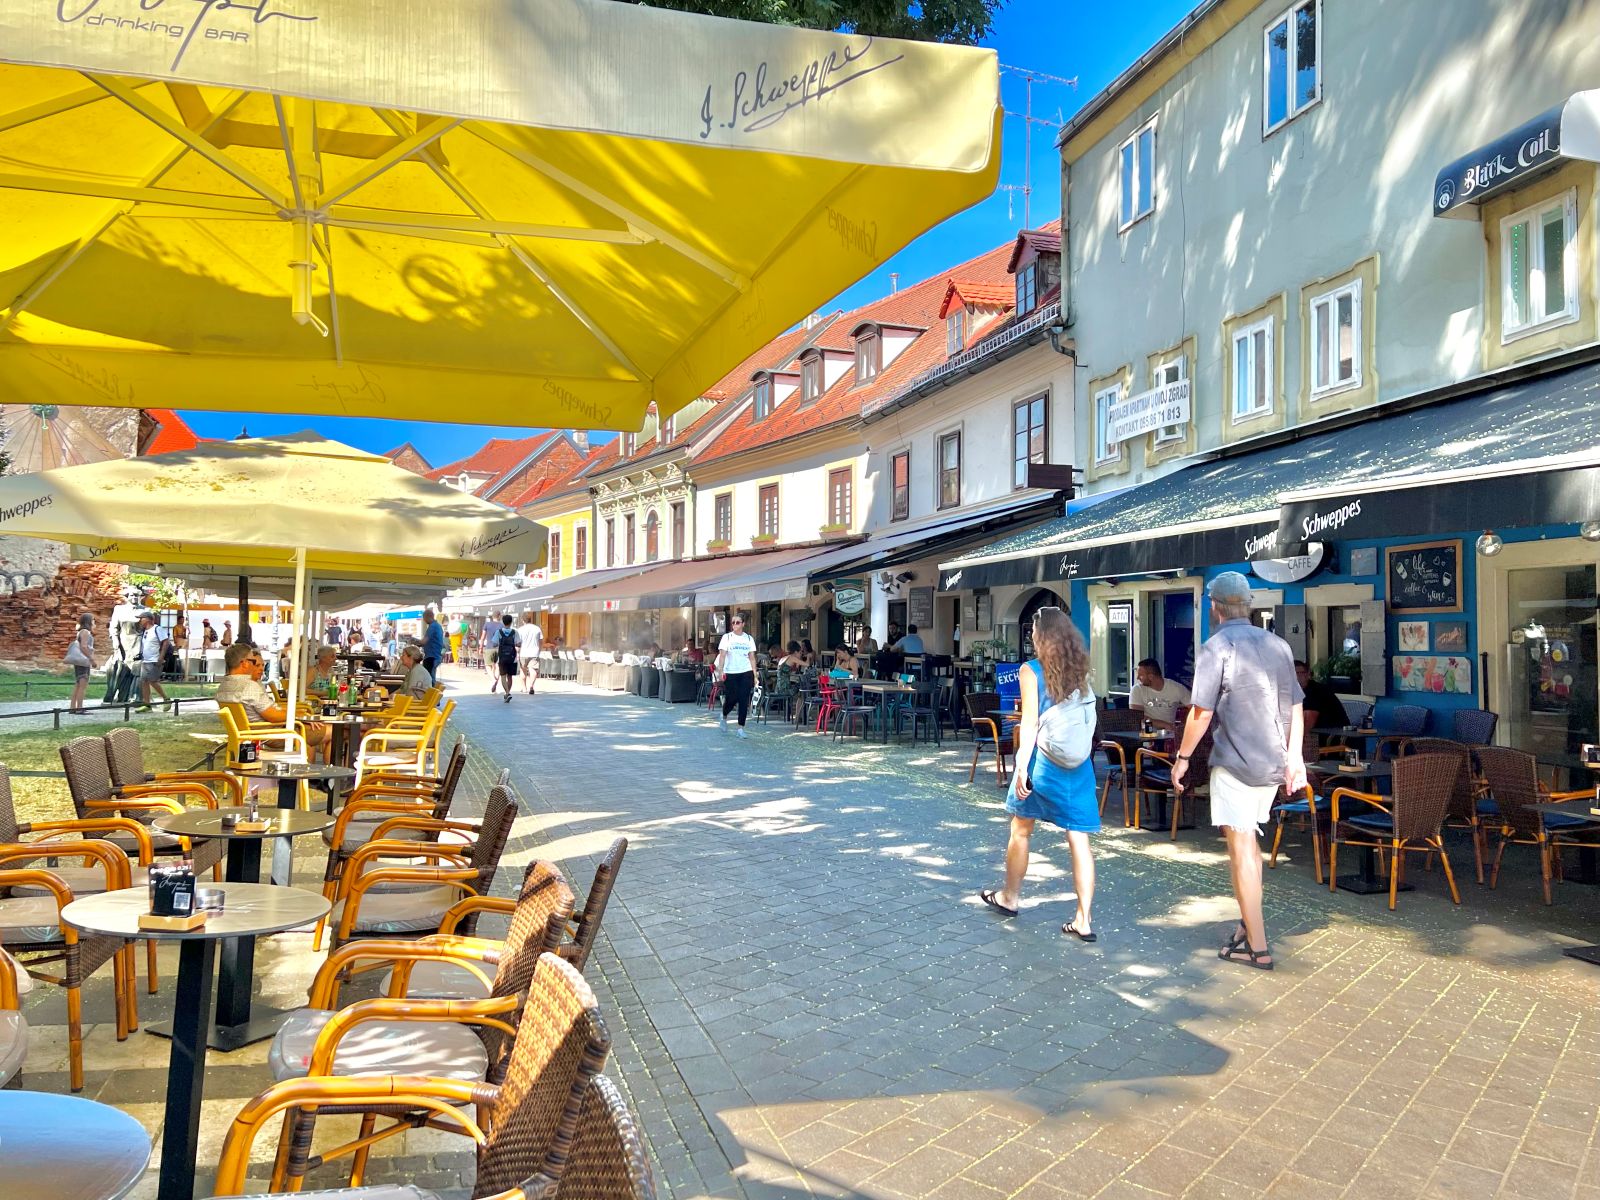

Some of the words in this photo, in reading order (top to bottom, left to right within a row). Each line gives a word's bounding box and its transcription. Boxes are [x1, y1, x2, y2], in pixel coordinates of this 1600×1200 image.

[86, 13, 184, 37] drinking
[204, 28, 250, 43] BAR
[1461, 154, 1517, 196] Black
[1517, 128, 1560, 167] Coil
[1167, 407, 1180, 420] 813
[0, 494, 53, 522] hweppes
[1301, 499, 1361, 541] Schweppes
[1244, 528, 1279, 561] Schwepp
[1287, 556, 1312, 570] CAFFE
[1112, 611, 1128, 621] ATM
[997, 671, 1020, 685] EXCH
